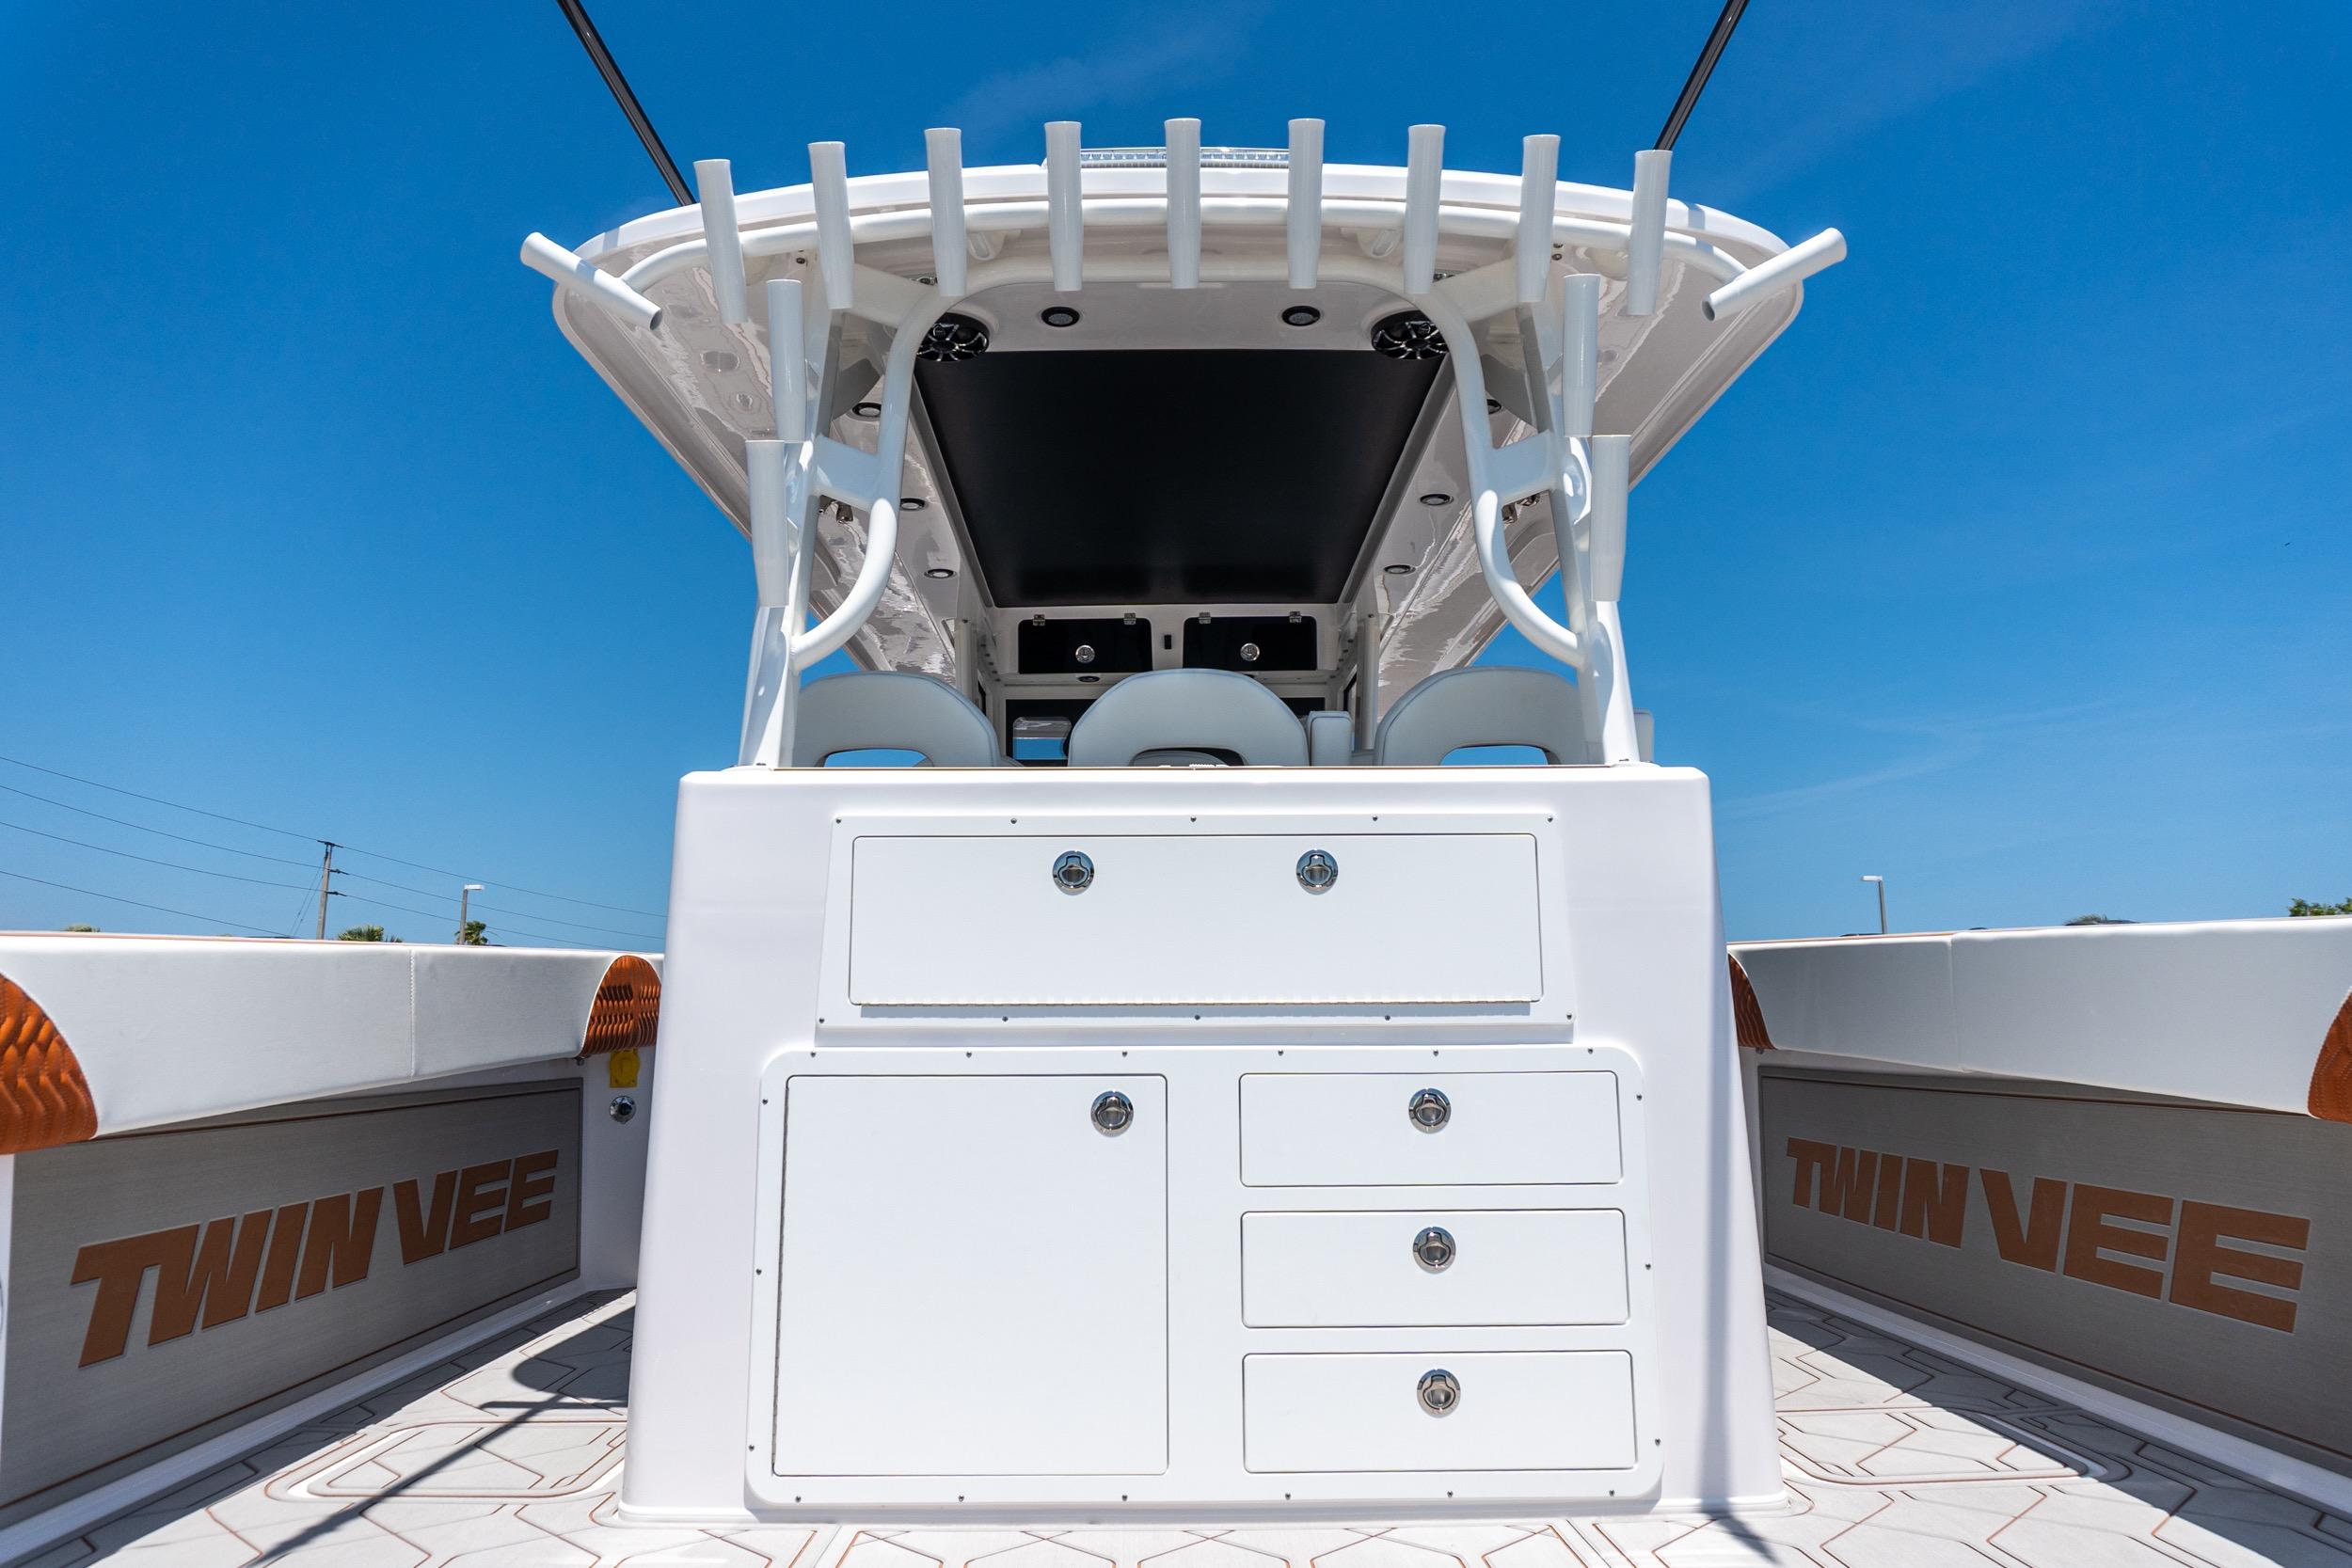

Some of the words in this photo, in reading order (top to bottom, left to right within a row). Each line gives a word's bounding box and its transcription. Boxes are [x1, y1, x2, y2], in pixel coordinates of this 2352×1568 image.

[71, 1186, 384, 1369] TWIN
[393, 1149, 559, 1265] VEE
[1787, 1136, 1970, 1249] TWIN
[1979, 1168, 2311, 1334] VEE
